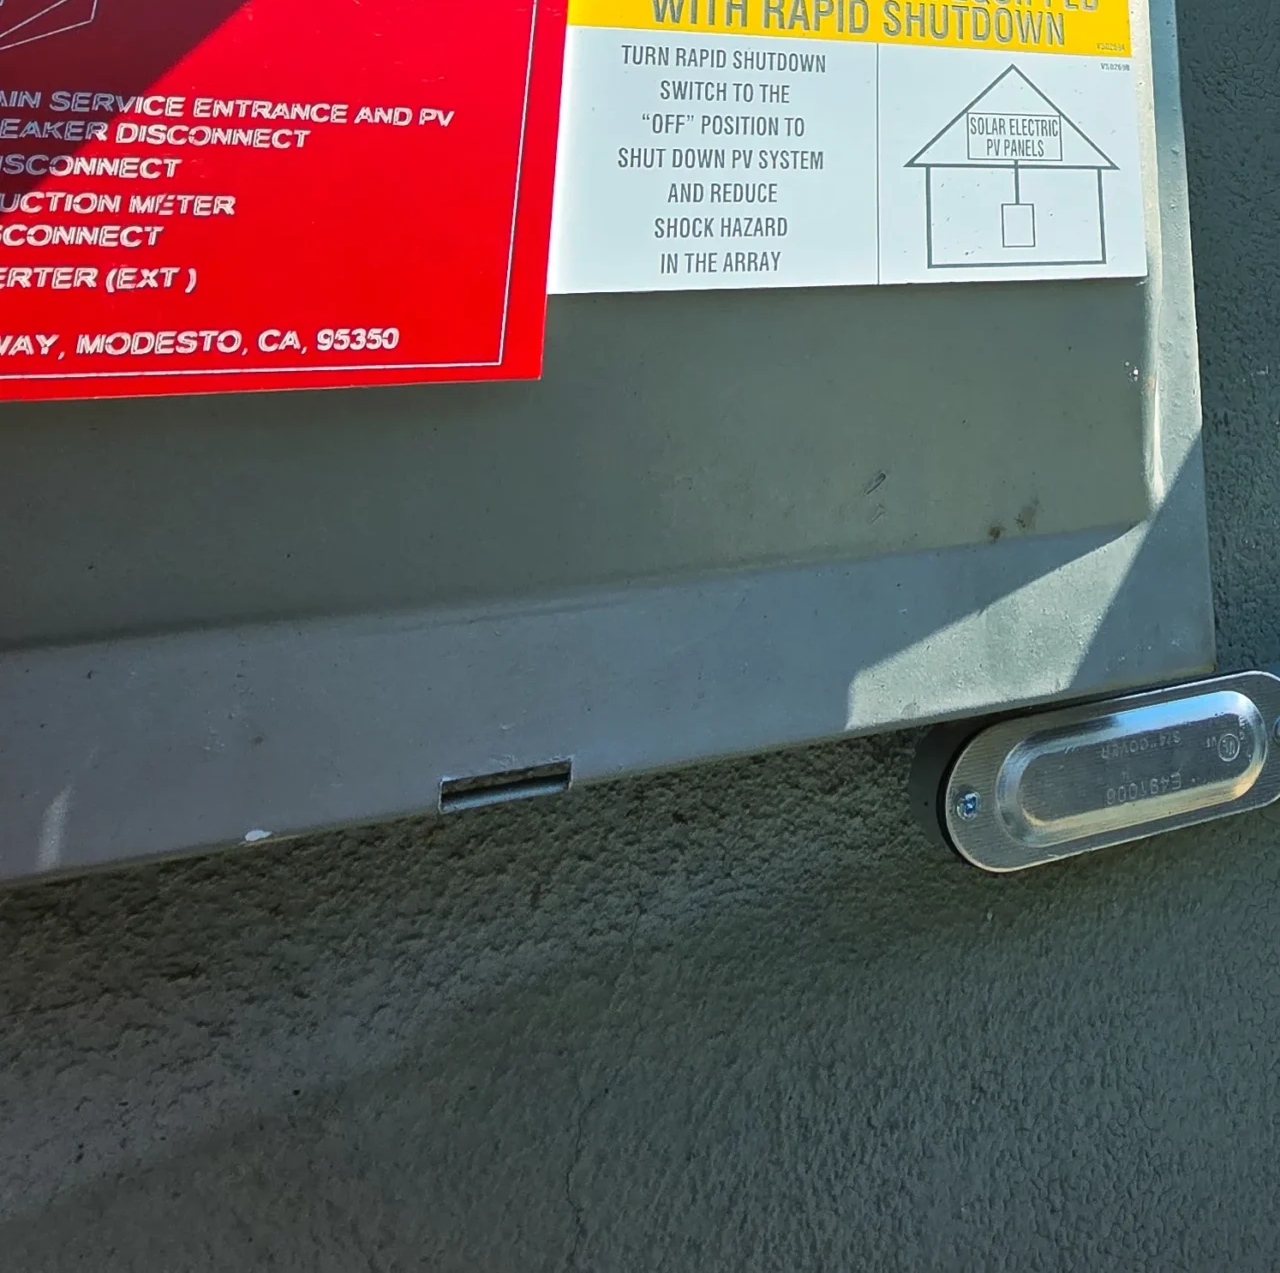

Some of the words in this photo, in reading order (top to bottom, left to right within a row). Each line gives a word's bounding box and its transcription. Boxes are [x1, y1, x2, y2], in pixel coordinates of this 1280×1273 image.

[882, 1, 1066, 47] SHUTDOWN
[621, 45, 670, 68] TURN
[675, 46, 728, 69] RAPID
[732, 48, 828, 74] SHUTDOWN
[660, 81, 728, 104] SWITCH
[732, 82, 754, 104] TO
[758, 83, 790, 105] THE
[49, 91, 185, 118] SERVICE
[193, 97, 348, 124] ENTRANCE
[354, 106, 413, 128] AND
[418, 109, 455, 128] PV
[0, 118, 108, 143] EAKER
[115, 122, 312, 150] DISCONNECT
[701, 114, 779, 137] POSITION
[783, 115, 806, 138] TO
[970, 116, 1007, 137] SOLAR
[1009, 117, 1060, 138] ELECTRIC
[617, 147, 666, 170] SHUT
[672, 148, 726, 171] DOWN
[731, 149, 754, 171] PV
[758, 149, 825, 171] SYSTEM
[986, 139, 1001, 157] PV
[1003, 139, 1045, 158] PANELS
[0, 191, 121, 215] UCTION
[129, 193, 237, 217] METER
[667, 183, 705, 204] AND
[709, 183, 779, 205] REDUCE
[0, 223, 164, 248] CONNECT
[654, 217, 716, 239] SHOCK
[720, 217, 789, 239] HAZARD
[660, 253, 681, 275] IN
[685, 252, 718, 274] THE
[723, 251, 781, 273] ARRAY
[77, 329, 249, 356] MODESTO,
[258, 329, 308, 355] CA,
[317, 328, 400, 352] 95350
